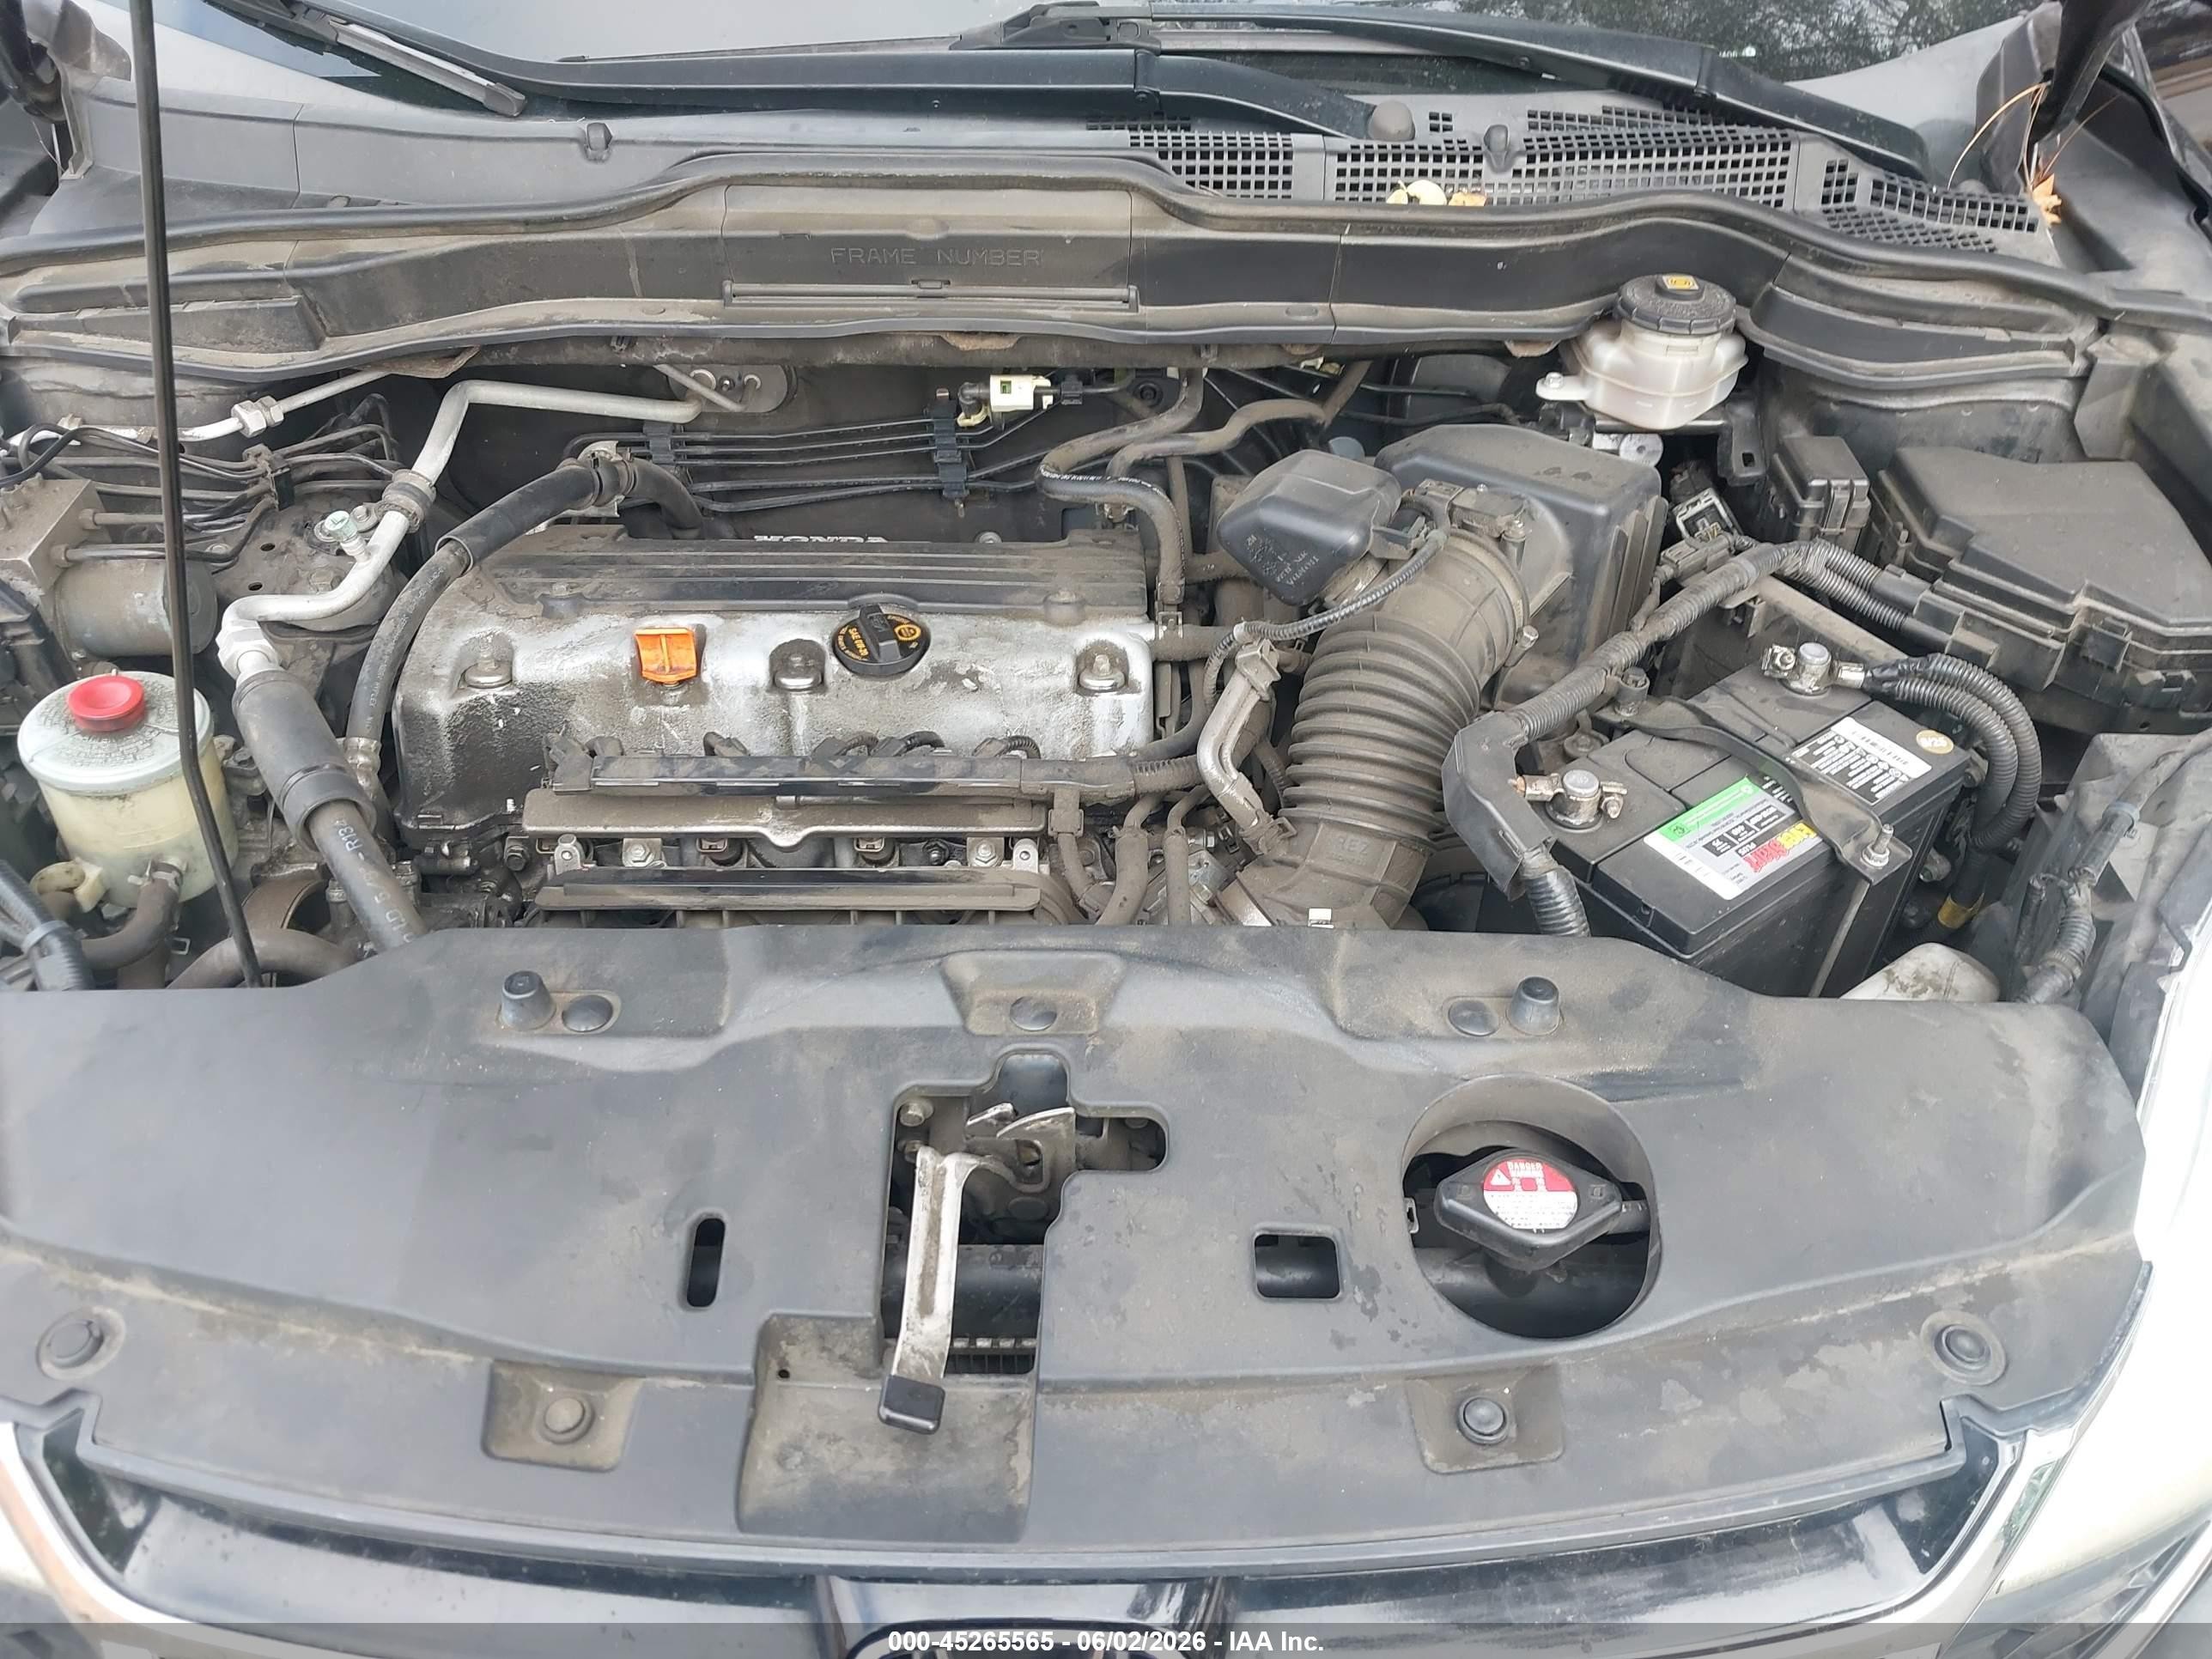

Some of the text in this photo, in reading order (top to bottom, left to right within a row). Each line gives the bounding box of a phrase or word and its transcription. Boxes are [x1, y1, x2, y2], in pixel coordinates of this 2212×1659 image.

[830, 246, 1043, 267] FRAME NUMBER
[848, 627, 861, 641] SAE
[1738, 841, 1757, 856] PLUS
